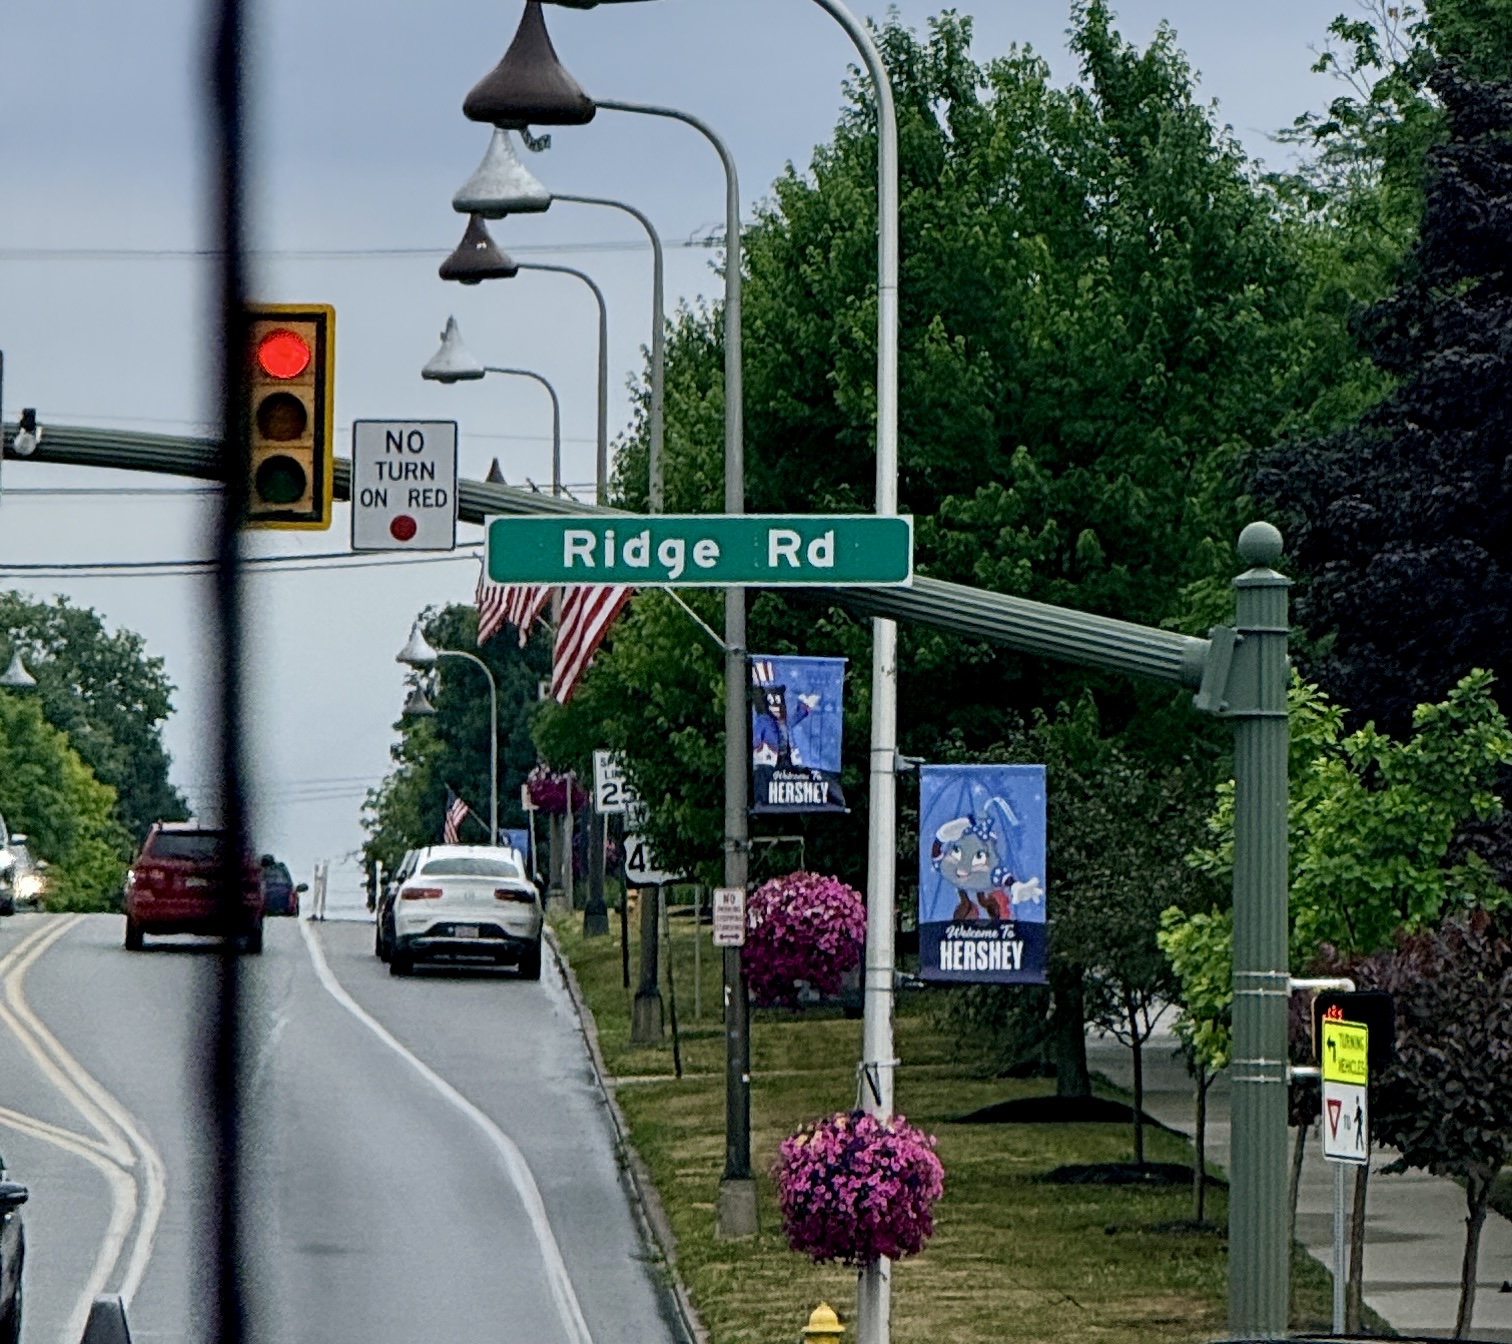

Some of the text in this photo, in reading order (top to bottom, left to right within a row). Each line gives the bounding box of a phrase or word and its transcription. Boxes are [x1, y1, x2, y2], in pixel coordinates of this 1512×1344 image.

[385, 429, 424, 454] NO
[375, 461, 435, 481] TURN
[360, 488, 448, 508] ON RED
[563, 528, 835, 580] Ridge Rd
[601, 782, 637, 805] 25
[768, 781, 829, 804] HERSHEY
[945, 923, 1016, 940] Welcome To
[940, 940, 1024, 971] HERSHEY
[1338, 1032, 1365, 1052] TURNING
[1338, 1057, 1366, 1076] VEHICLES
